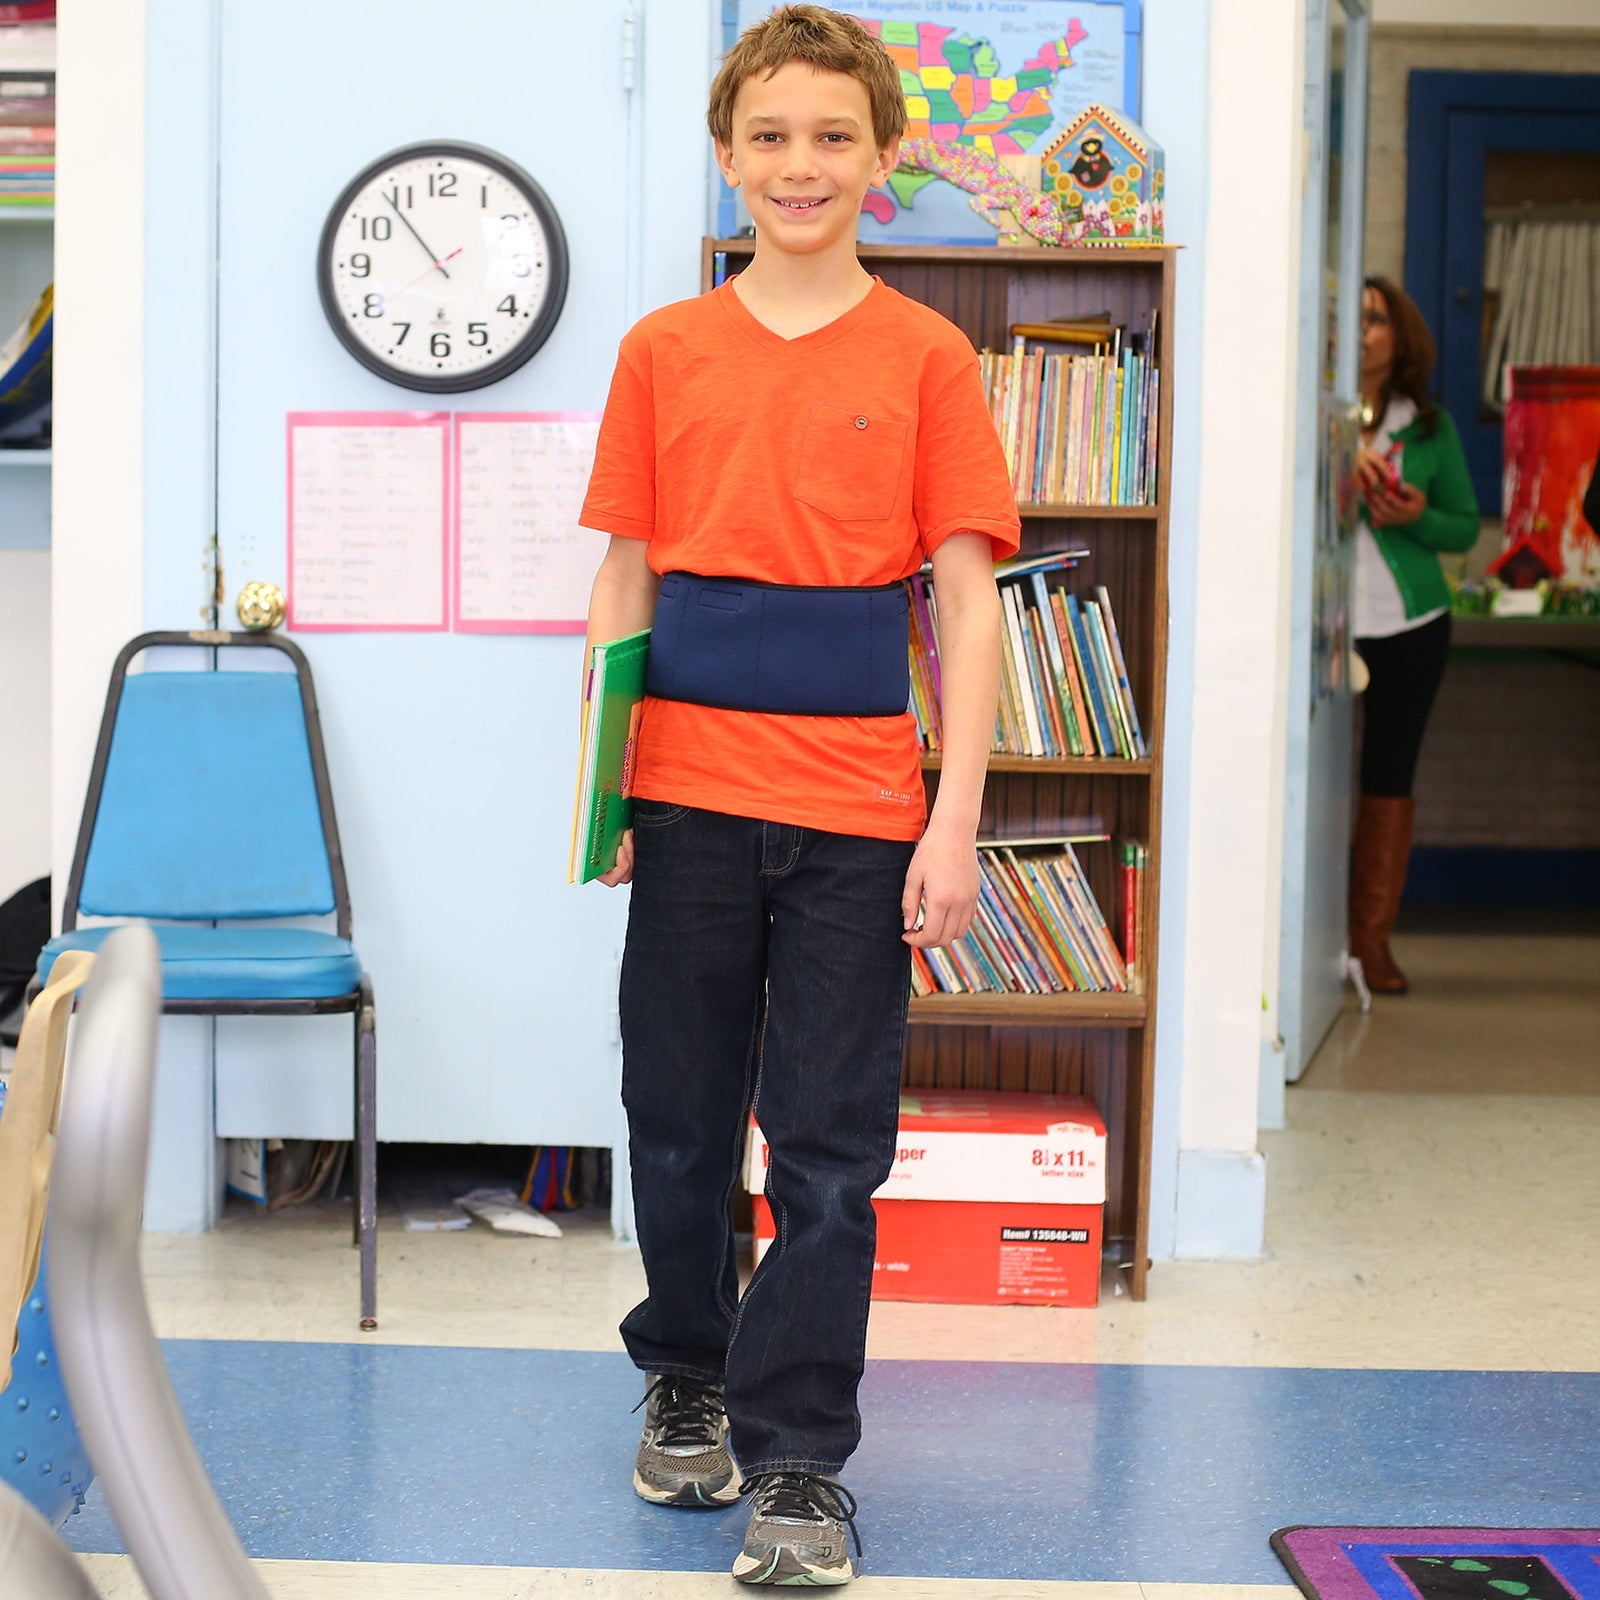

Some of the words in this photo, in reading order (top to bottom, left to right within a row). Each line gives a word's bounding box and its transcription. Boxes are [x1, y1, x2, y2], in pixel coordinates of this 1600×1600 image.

[868, 1, 920, 13] Magnetic
[926, 1, 943, 11] US
[946, 2, 971, 14] Map
[975, 3, 984, 12] &
[989, 2, 1028, 13] Puzzle
[429, 173, 457, 197] 12
[481, 185, 487, 208] 1
[394, 186, 413, 209] 11
[361, 216, 392, 241] 10
[350, 253, 371, 278] 9
[363, 293, 384, 318] 8
[496, 294, 518, 317] 4
[392, 323, 411, 346] 7
[430, 333, 451, 357] 6
[468, 323, 489, 347] 5
[894, 1148, 926, 1163] per
[1053, 1153, 1064, 1166] x
[1067, 1150, 1084, 1166] 11
[1002, 1229, 1031, 1240] Item#
